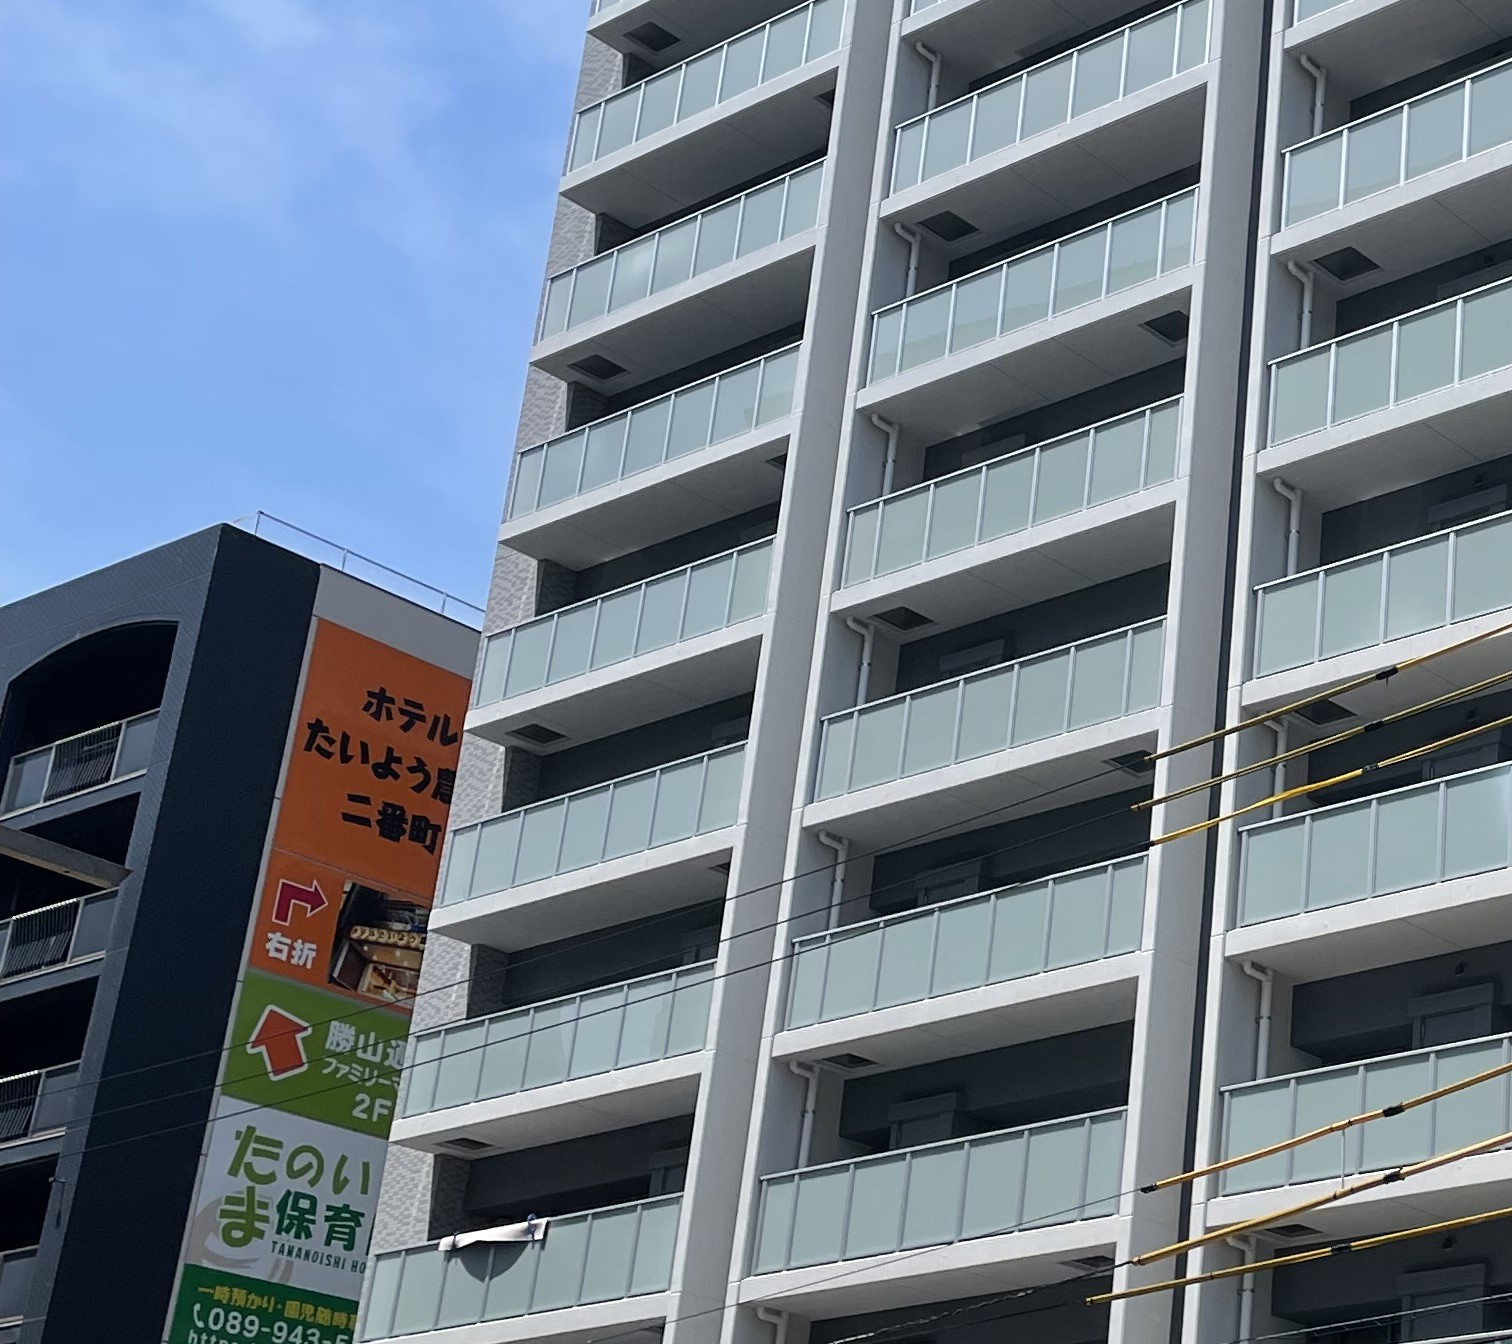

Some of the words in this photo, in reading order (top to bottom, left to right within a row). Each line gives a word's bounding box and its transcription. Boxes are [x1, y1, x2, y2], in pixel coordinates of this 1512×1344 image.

[361, 686, 459, 747] ホテル
[340, 792, 442, 855] 二番町
[265, 931, 318, 969] 右折
[351, 1093, 393, 1123] 2F
